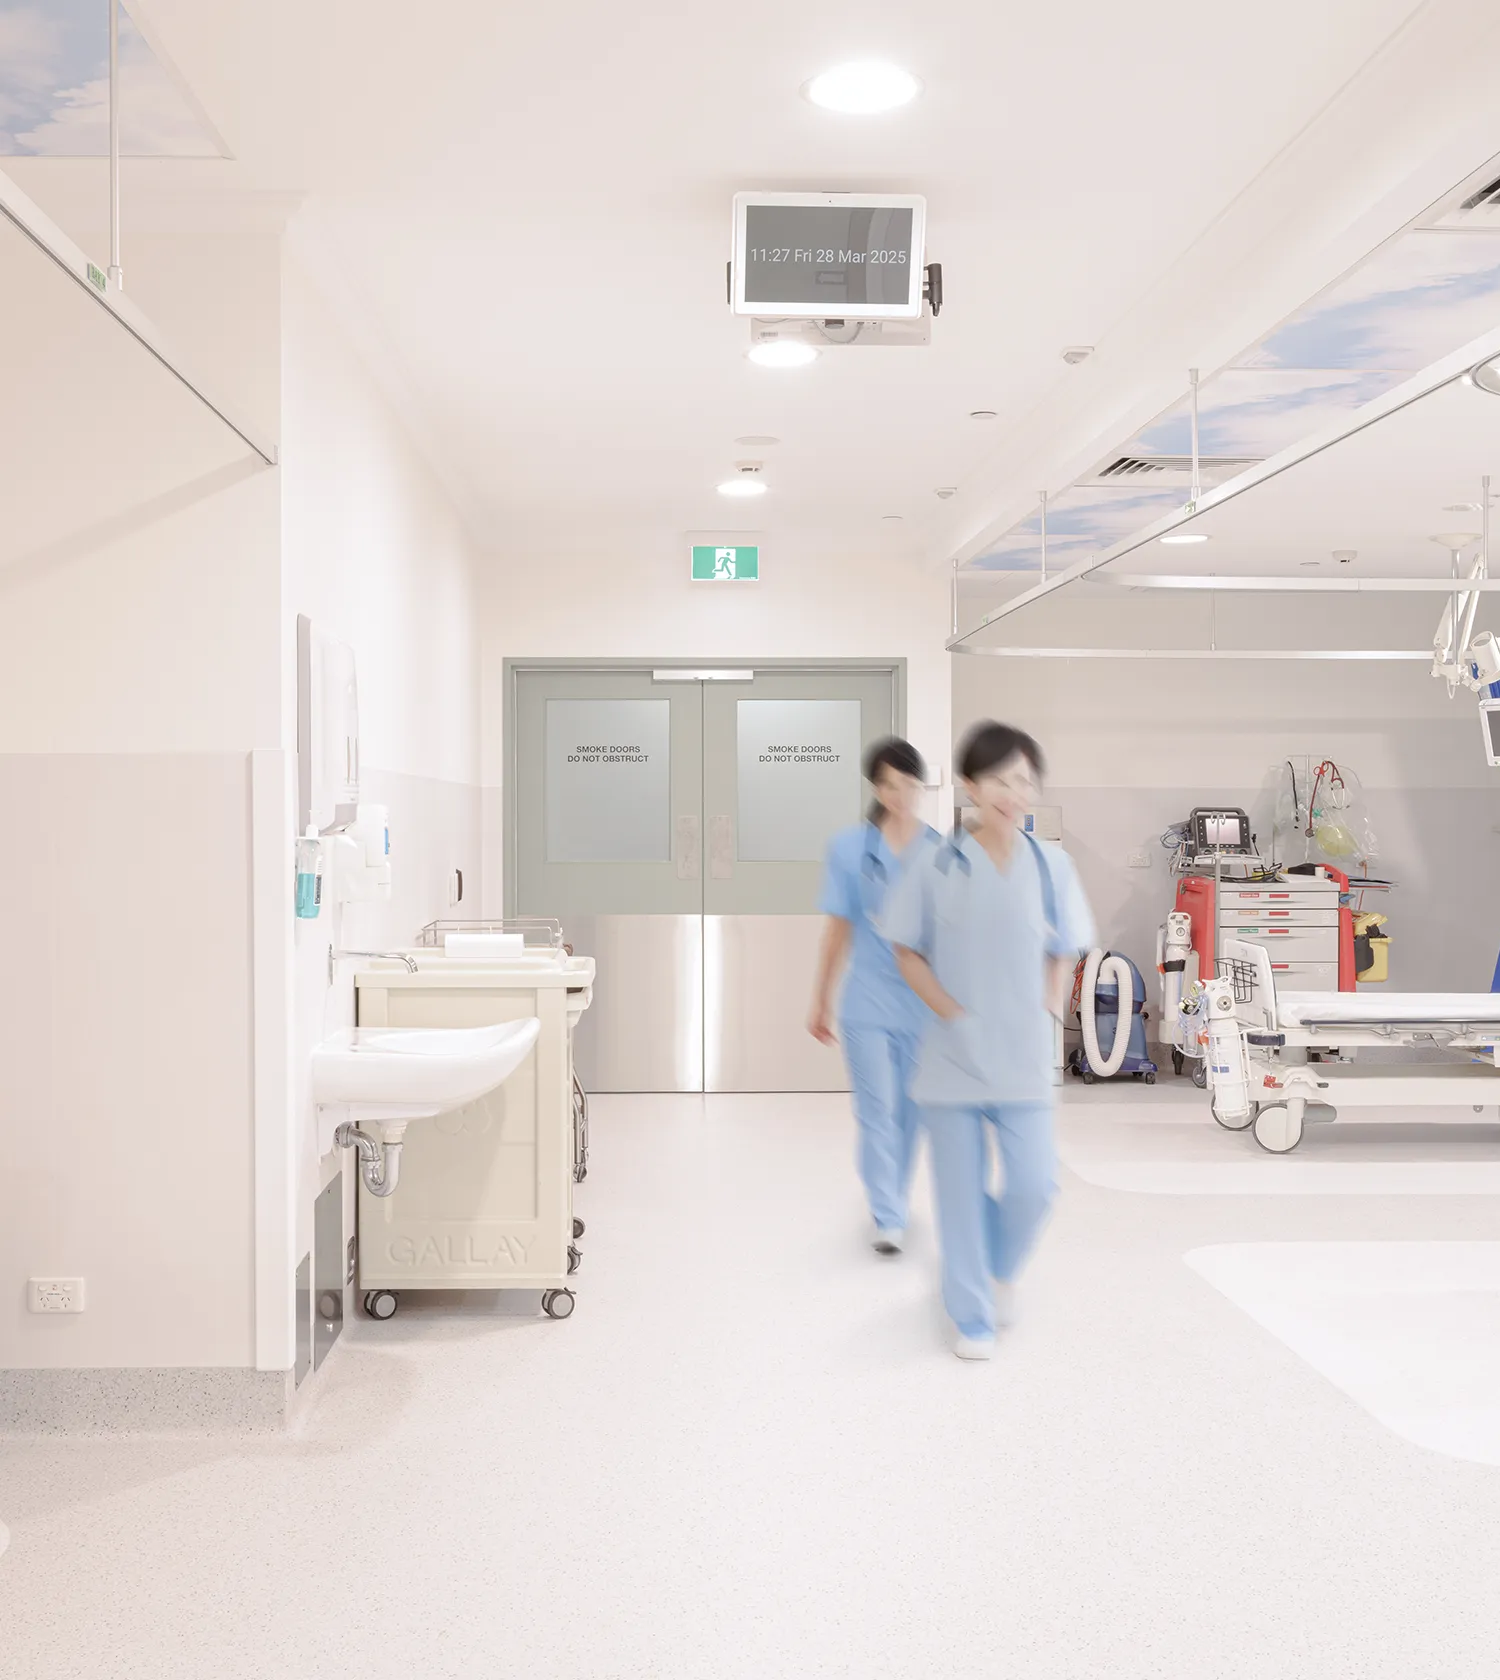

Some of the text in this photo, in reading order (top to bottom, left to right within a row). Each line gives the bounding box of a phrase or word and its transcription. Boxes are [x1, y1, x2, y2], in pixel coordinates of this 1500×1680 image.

[750, 248, 907, 264] 11:27 Fri 28 Mar 2025
[576, 745, 641, 753] SMOKE DOORS
[767, 745, 832, 753] SMOKE DOORS
[567, 754, 649, 763] DO NOT OBSTRUCT
[758, 754, 840, 763] DO NOT OBSTRUCT
[386, 1234, 538, 1267] GALLAY
